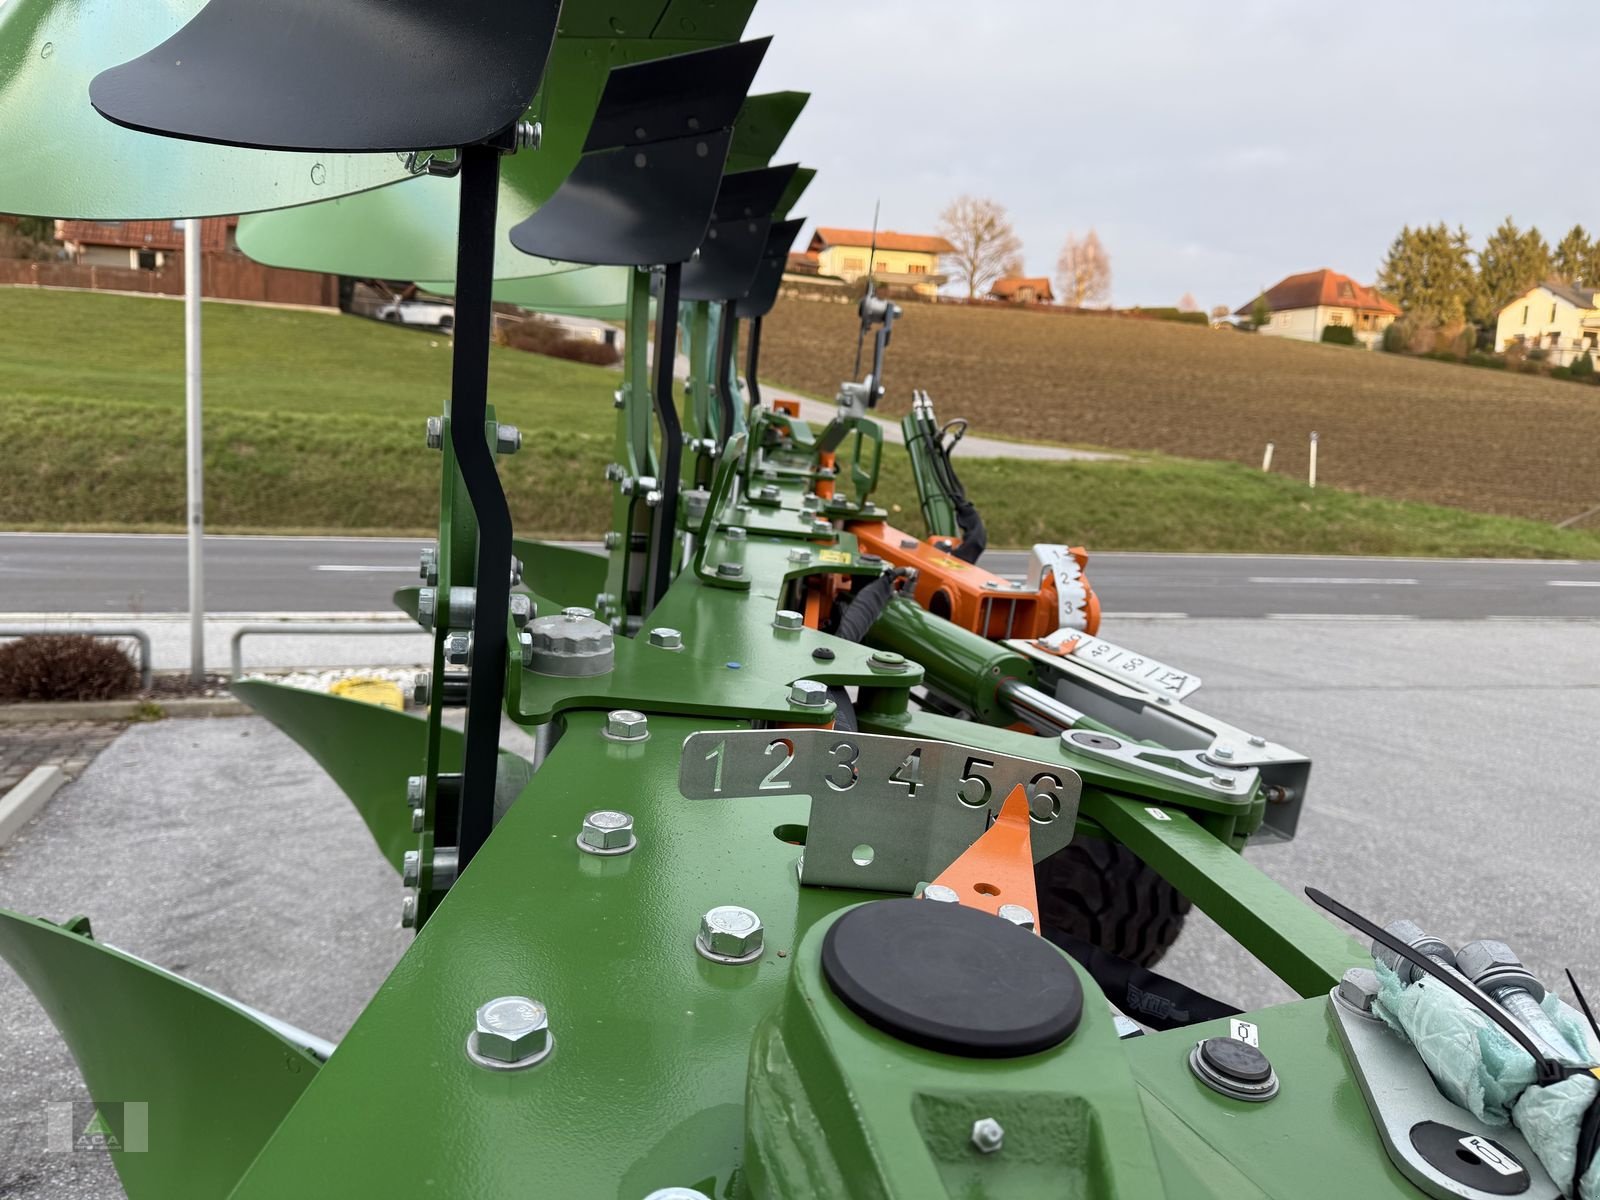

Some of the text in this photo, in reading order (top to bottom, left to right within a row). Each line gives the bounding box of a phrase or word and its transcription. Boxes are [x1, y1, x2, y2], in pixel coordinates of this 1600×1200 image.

[1060, 572, 1070, 585] 2
[1064, 601, 1074, 615] 3
[1090, 643, 1111, 658] 40
[1122, 657, 1144, 671] 50
[704, 738, 1065, 825] 1 2 3 4 5 6
